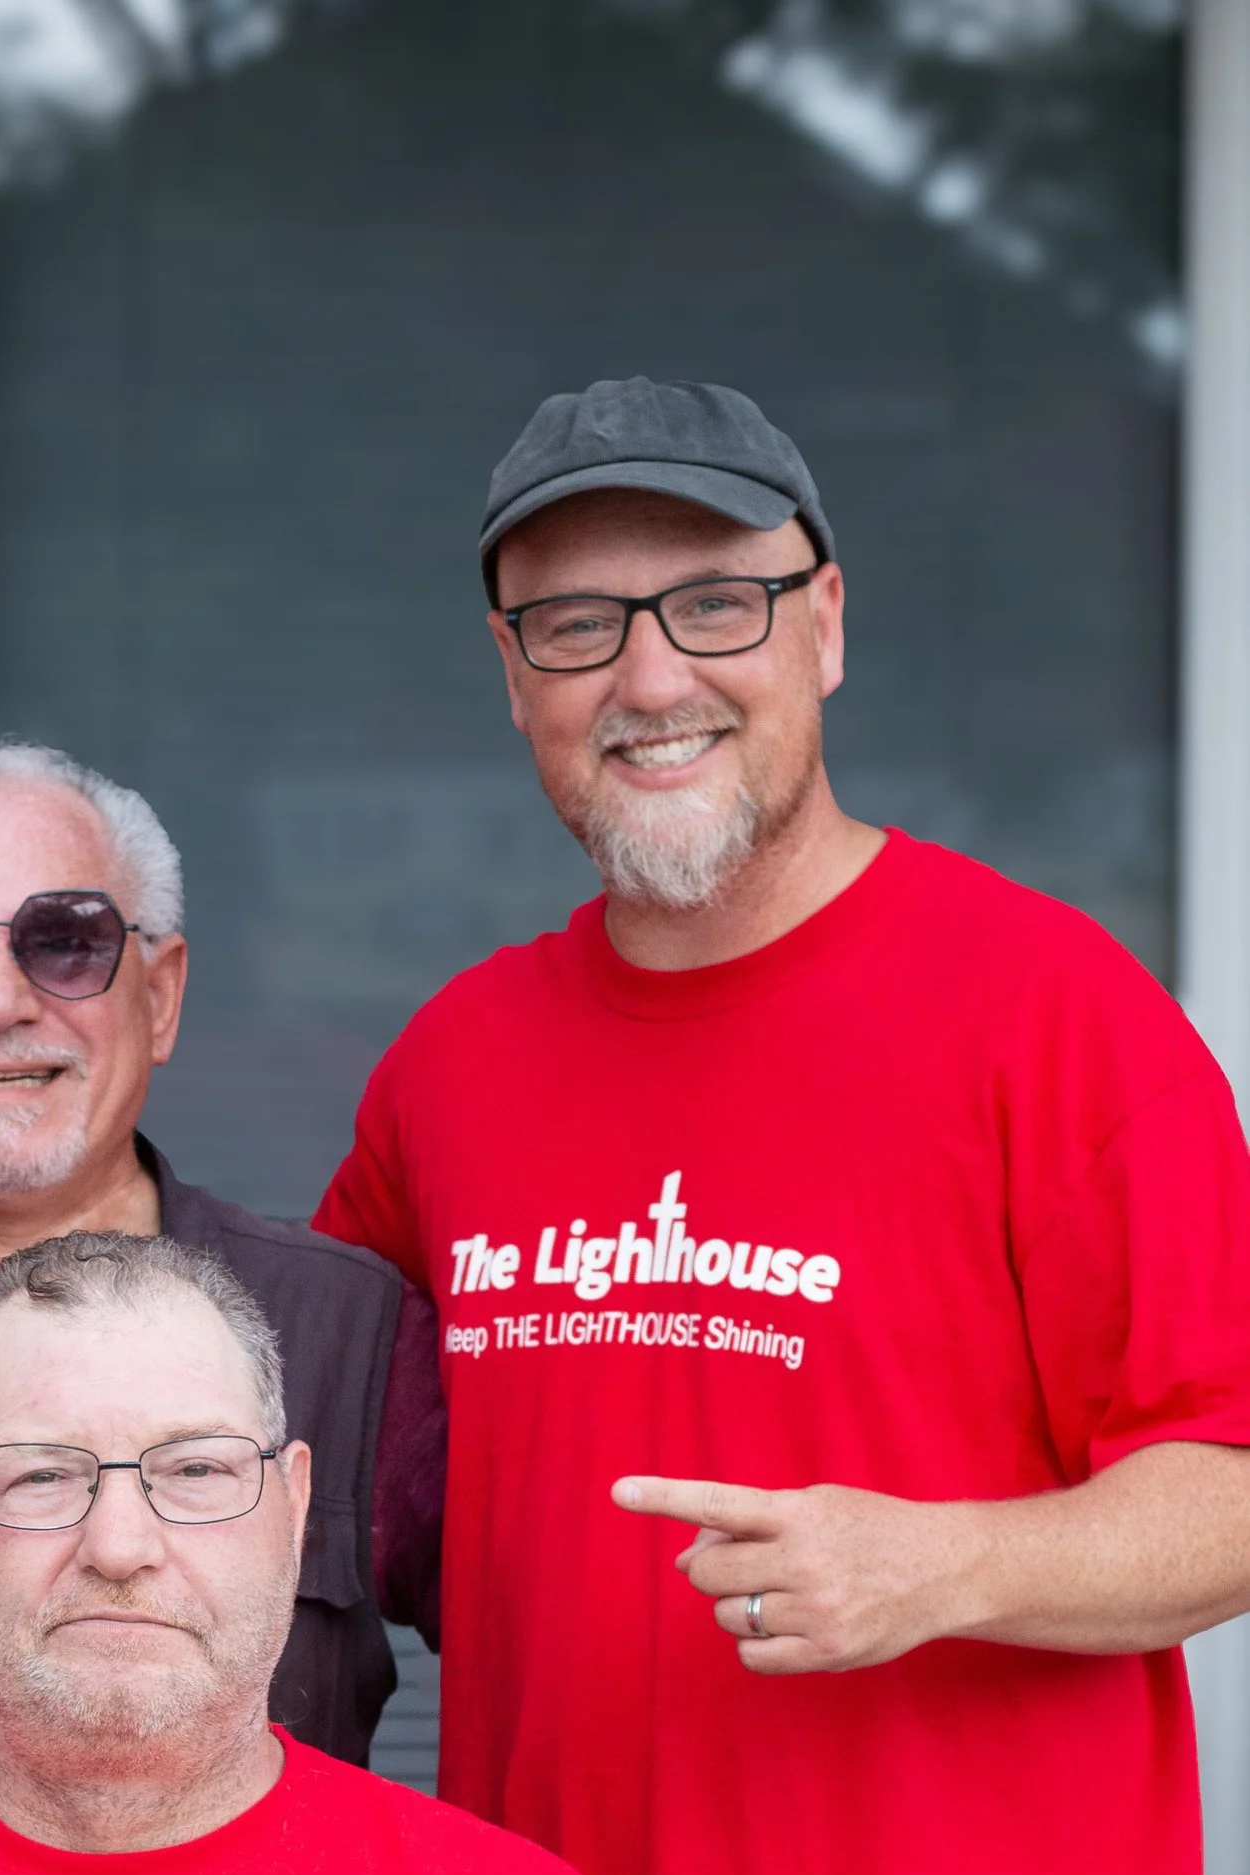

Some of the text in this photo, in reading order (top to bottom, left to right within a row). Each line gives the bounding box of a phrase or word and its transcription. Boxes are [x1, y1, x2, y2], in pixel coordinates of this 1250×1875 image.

[451, 1170, 841, 1303] The Lighthouse
[493, 1313, 541, 1349] THE
[544, 1311, 702, 1347] LIGHTHOUSE
[703, 1315, 805, 1370] Shining
